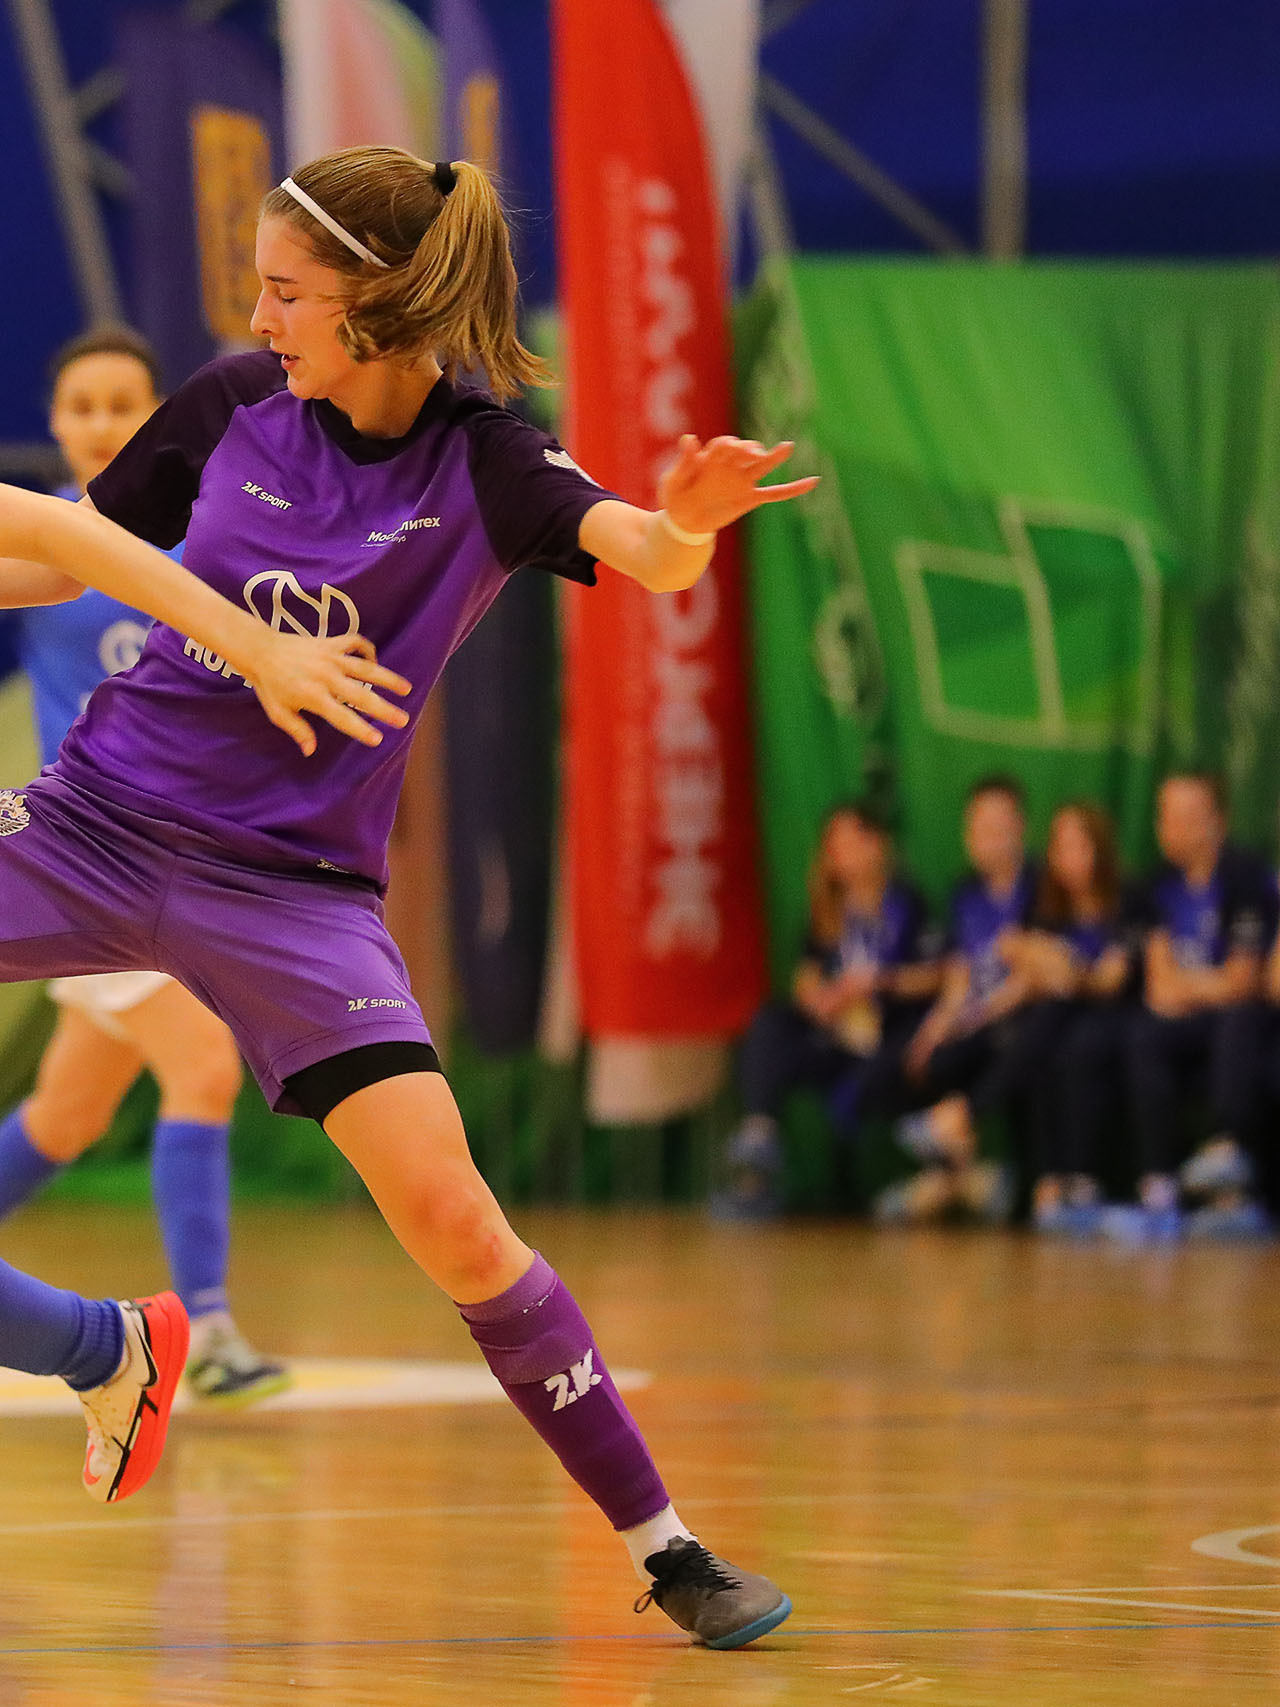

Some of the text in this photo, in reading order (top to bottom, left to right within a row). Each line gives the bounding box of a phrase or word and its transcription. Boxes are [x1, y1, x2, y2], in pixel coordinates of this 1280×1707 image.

[241, 481, 292, 510] 2K SPORT
[348, 998, 407, 1012] 2K SPORT
[544, 1348, 603, 1412] 2K
